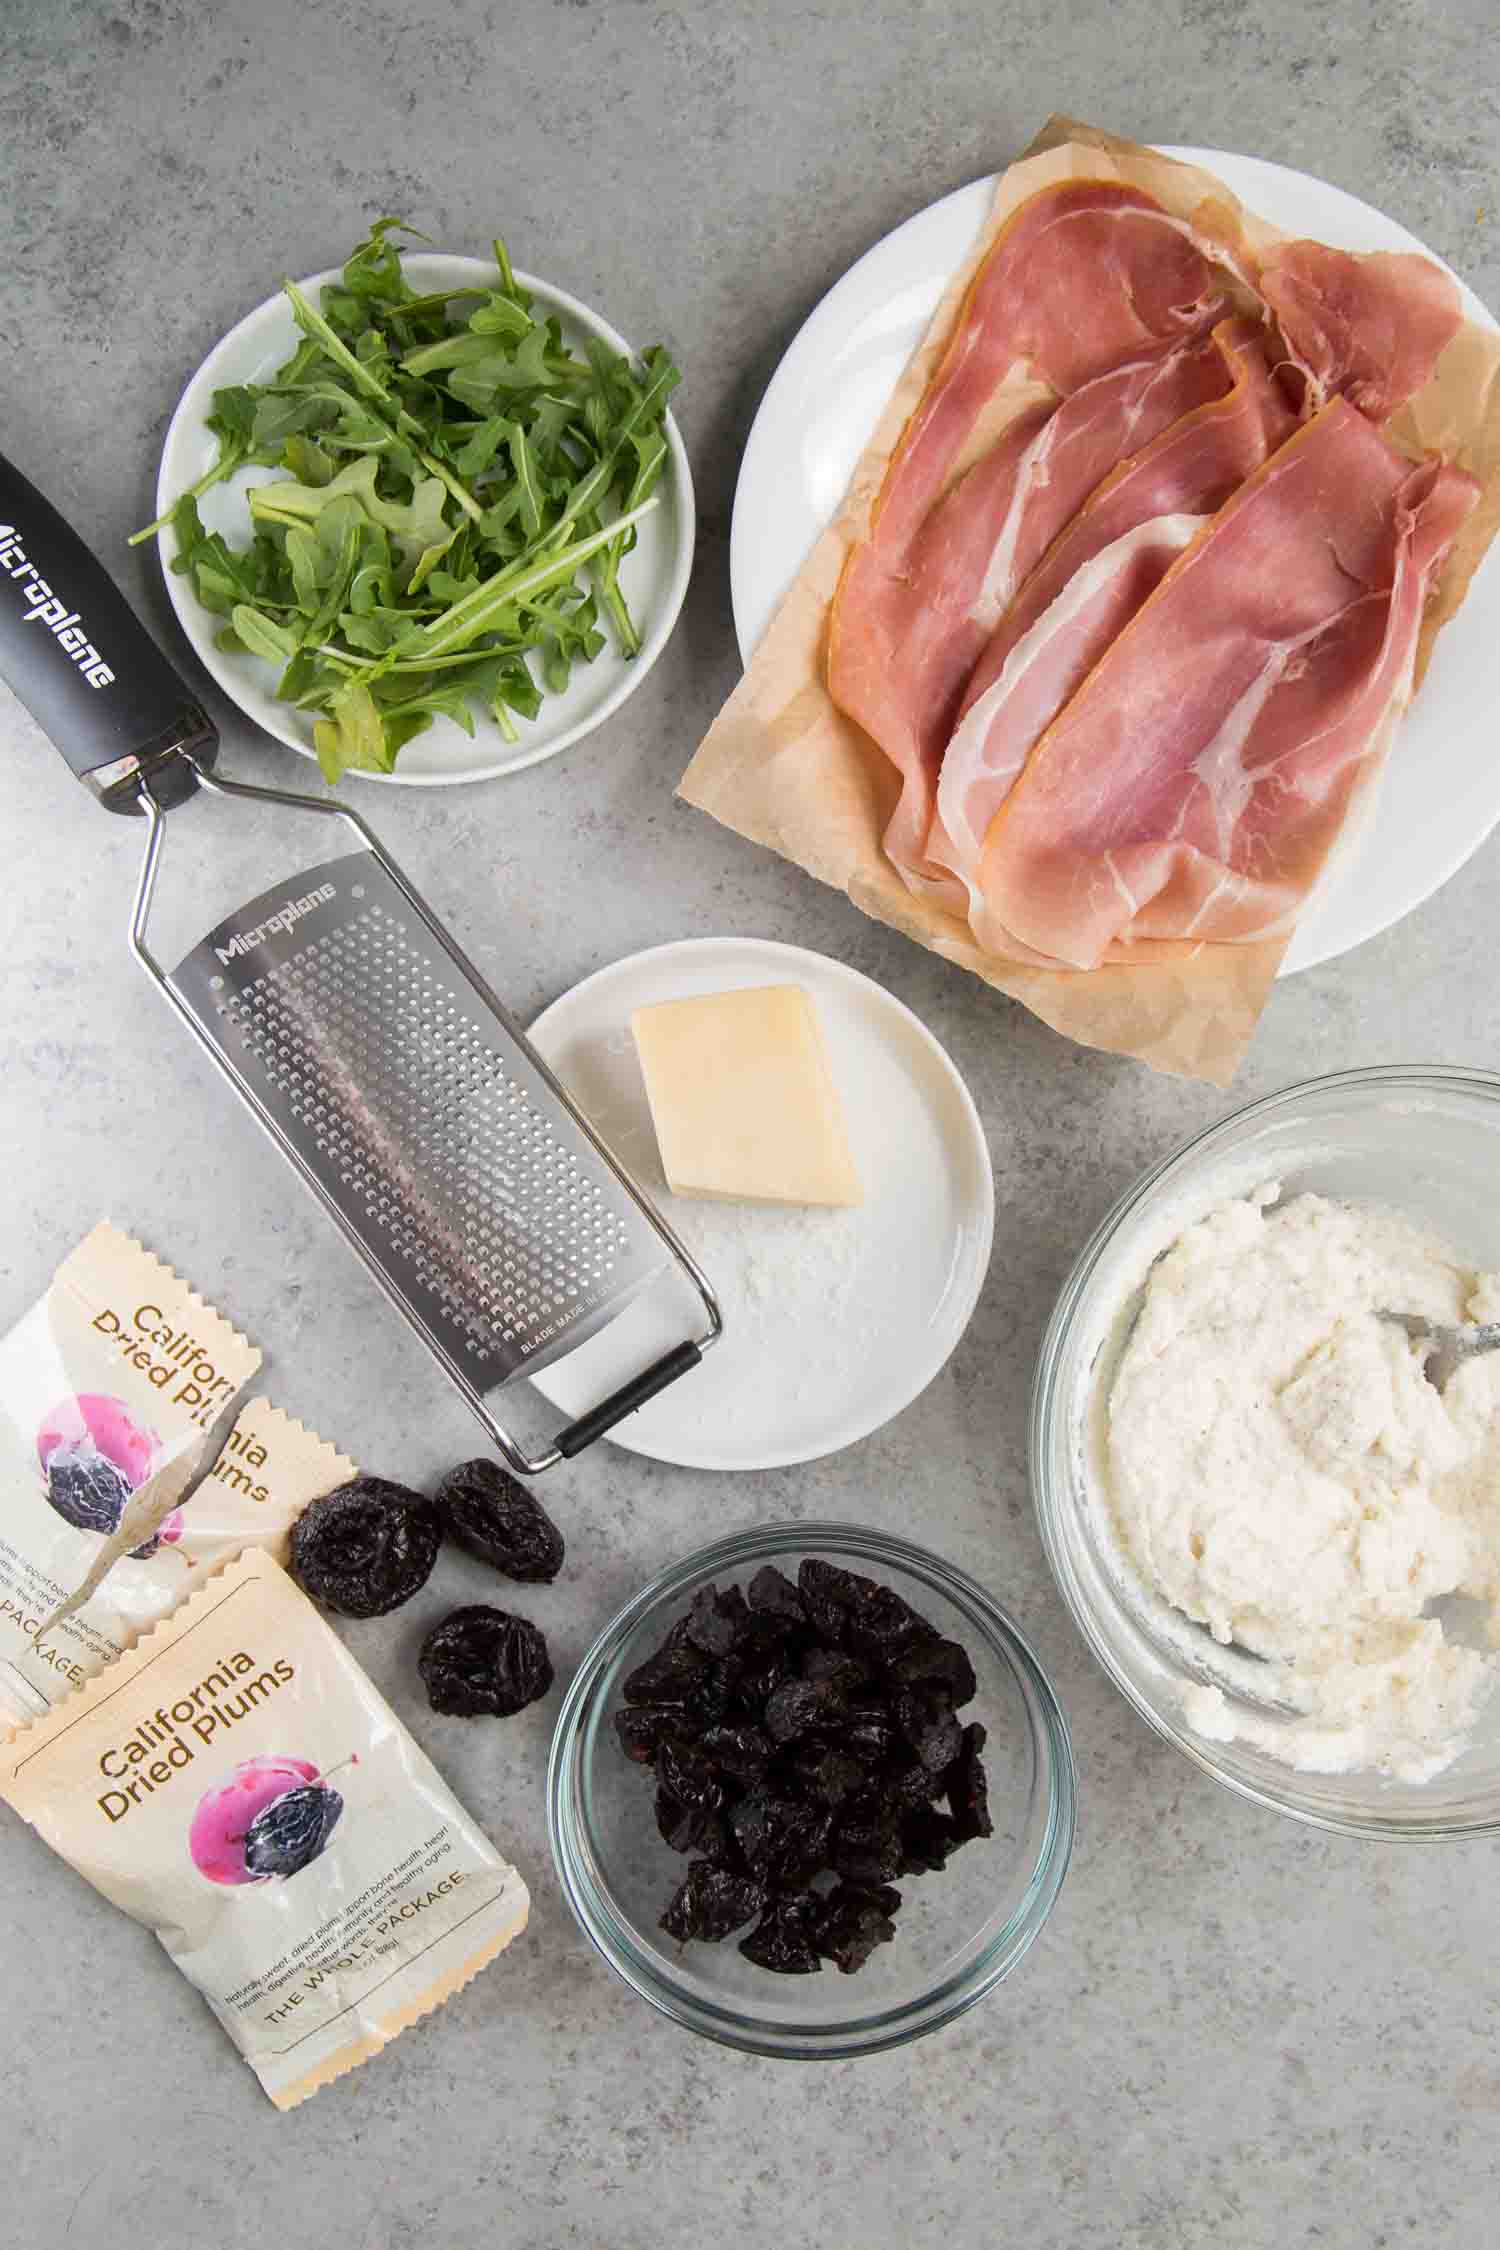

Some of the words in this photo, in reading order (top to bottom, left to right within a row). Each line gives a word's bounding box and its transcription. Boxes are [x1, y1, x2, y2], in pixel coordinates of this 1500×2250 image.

[214, 883, 337, 966] Microplane
[92, 1309, 178, 1389] Dried
[520, 1326, 556, 1354] BLADE
[97, 1736, 195, 1823] Dried
[191, 1659, 295, 1744] Plums
[100, 1652, 256, 1778] California
[370, 1872, 394, 1895] bone
[264, 1991, 305, 2025] THE
[303, 1936, 376, 1990] WHOLE
